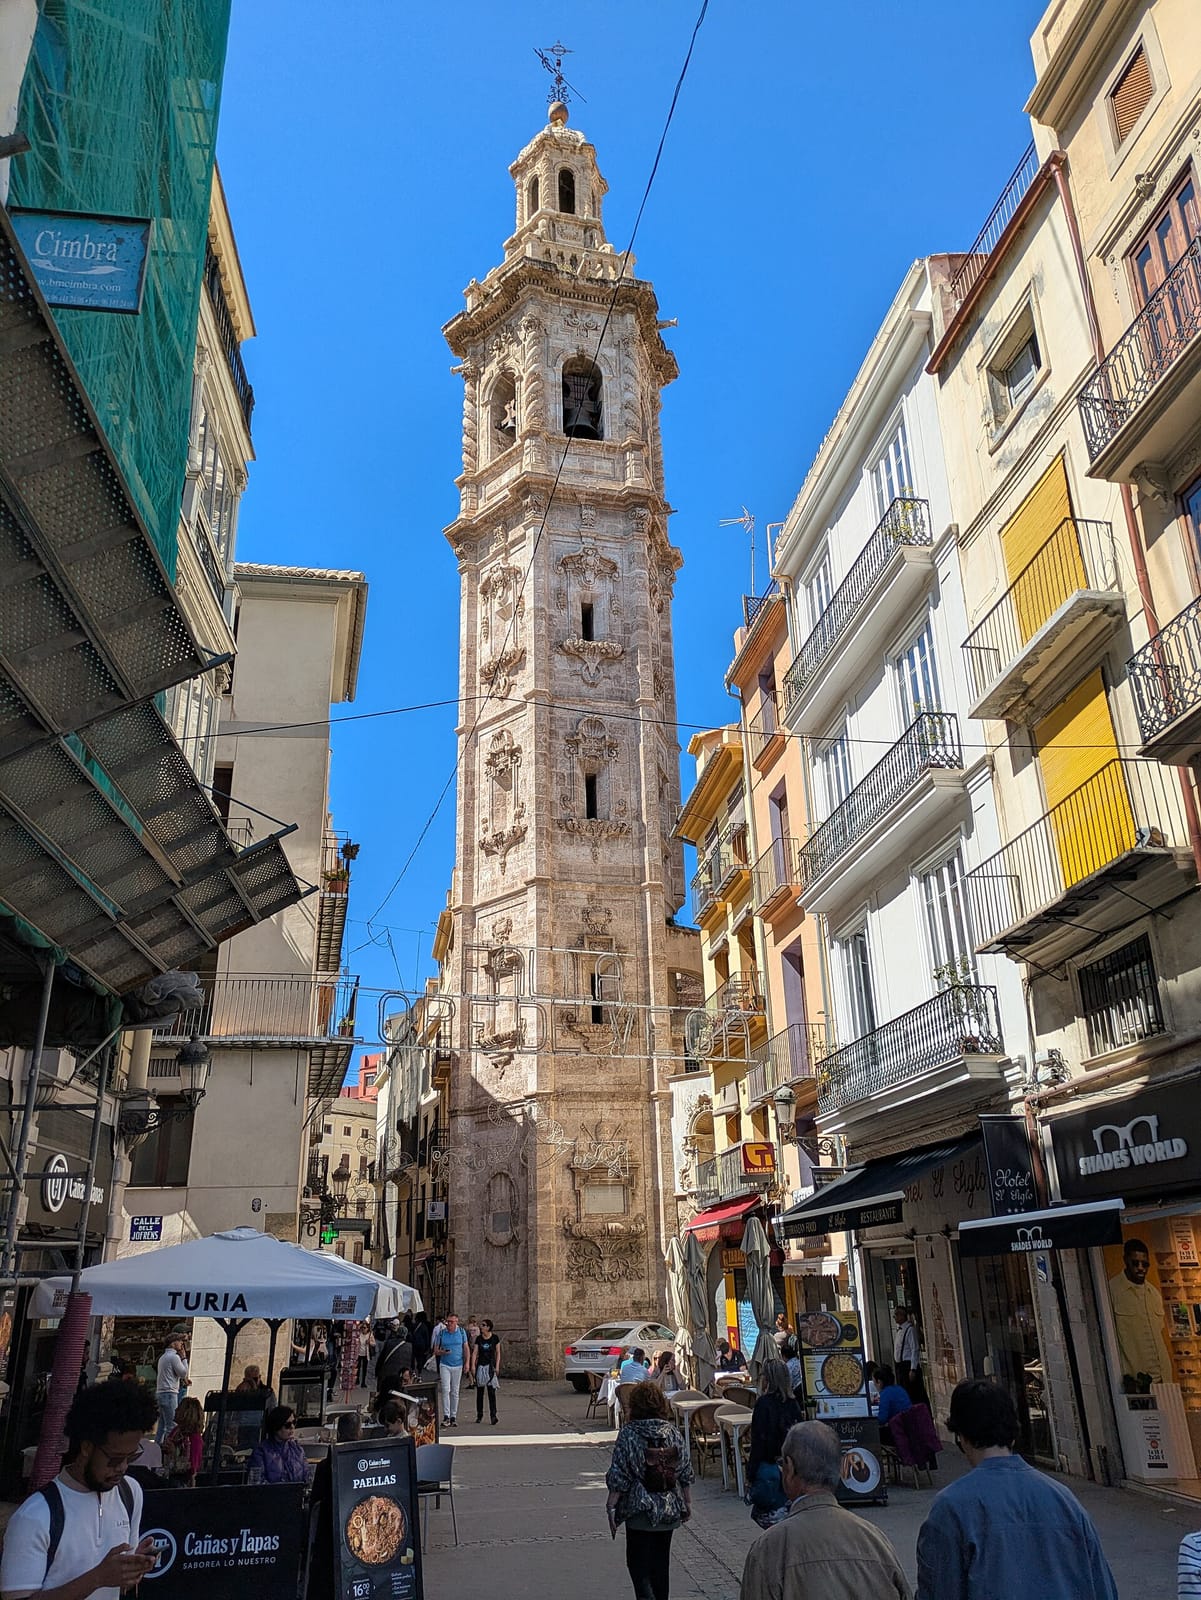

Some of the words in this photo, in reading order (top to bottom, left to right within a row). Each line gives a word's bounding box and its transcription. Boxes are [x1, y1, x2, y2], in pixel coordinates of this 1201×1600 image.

[35, 230, 117, 261] Cimbra
[1079, 1149, 1131, 1176] SHADES
[1130, 1138, 1187, 1166] WORLD
[746, 1166, 775, 1174] TABACOS
[994, 1169, 1031, 1188] Hotel
[133, 1217, 160, 1226] CALLE
[860, 1206, 897, 1225] RESTAURANTE
[131, 1231, 158, 1241] JOFRENS
[1011, 1239, 1032, 1251] SHADES
[1032, 1238, 1053, 1250] WORLD
[168, 1291, 248, 1312] TURIA
[352, 1474, 397, 1489] PAELLAS
[184, 1531, 229, 1556] Cañas
[229, 1537, 240, 1556] y
[240, 1528, 280, 1554] Tapas
[182, 1561, 221, 1570] SABOREA
[223, 1559, 235, 1567] LO
[238, 1555, 277, 1566] NUESTRO
